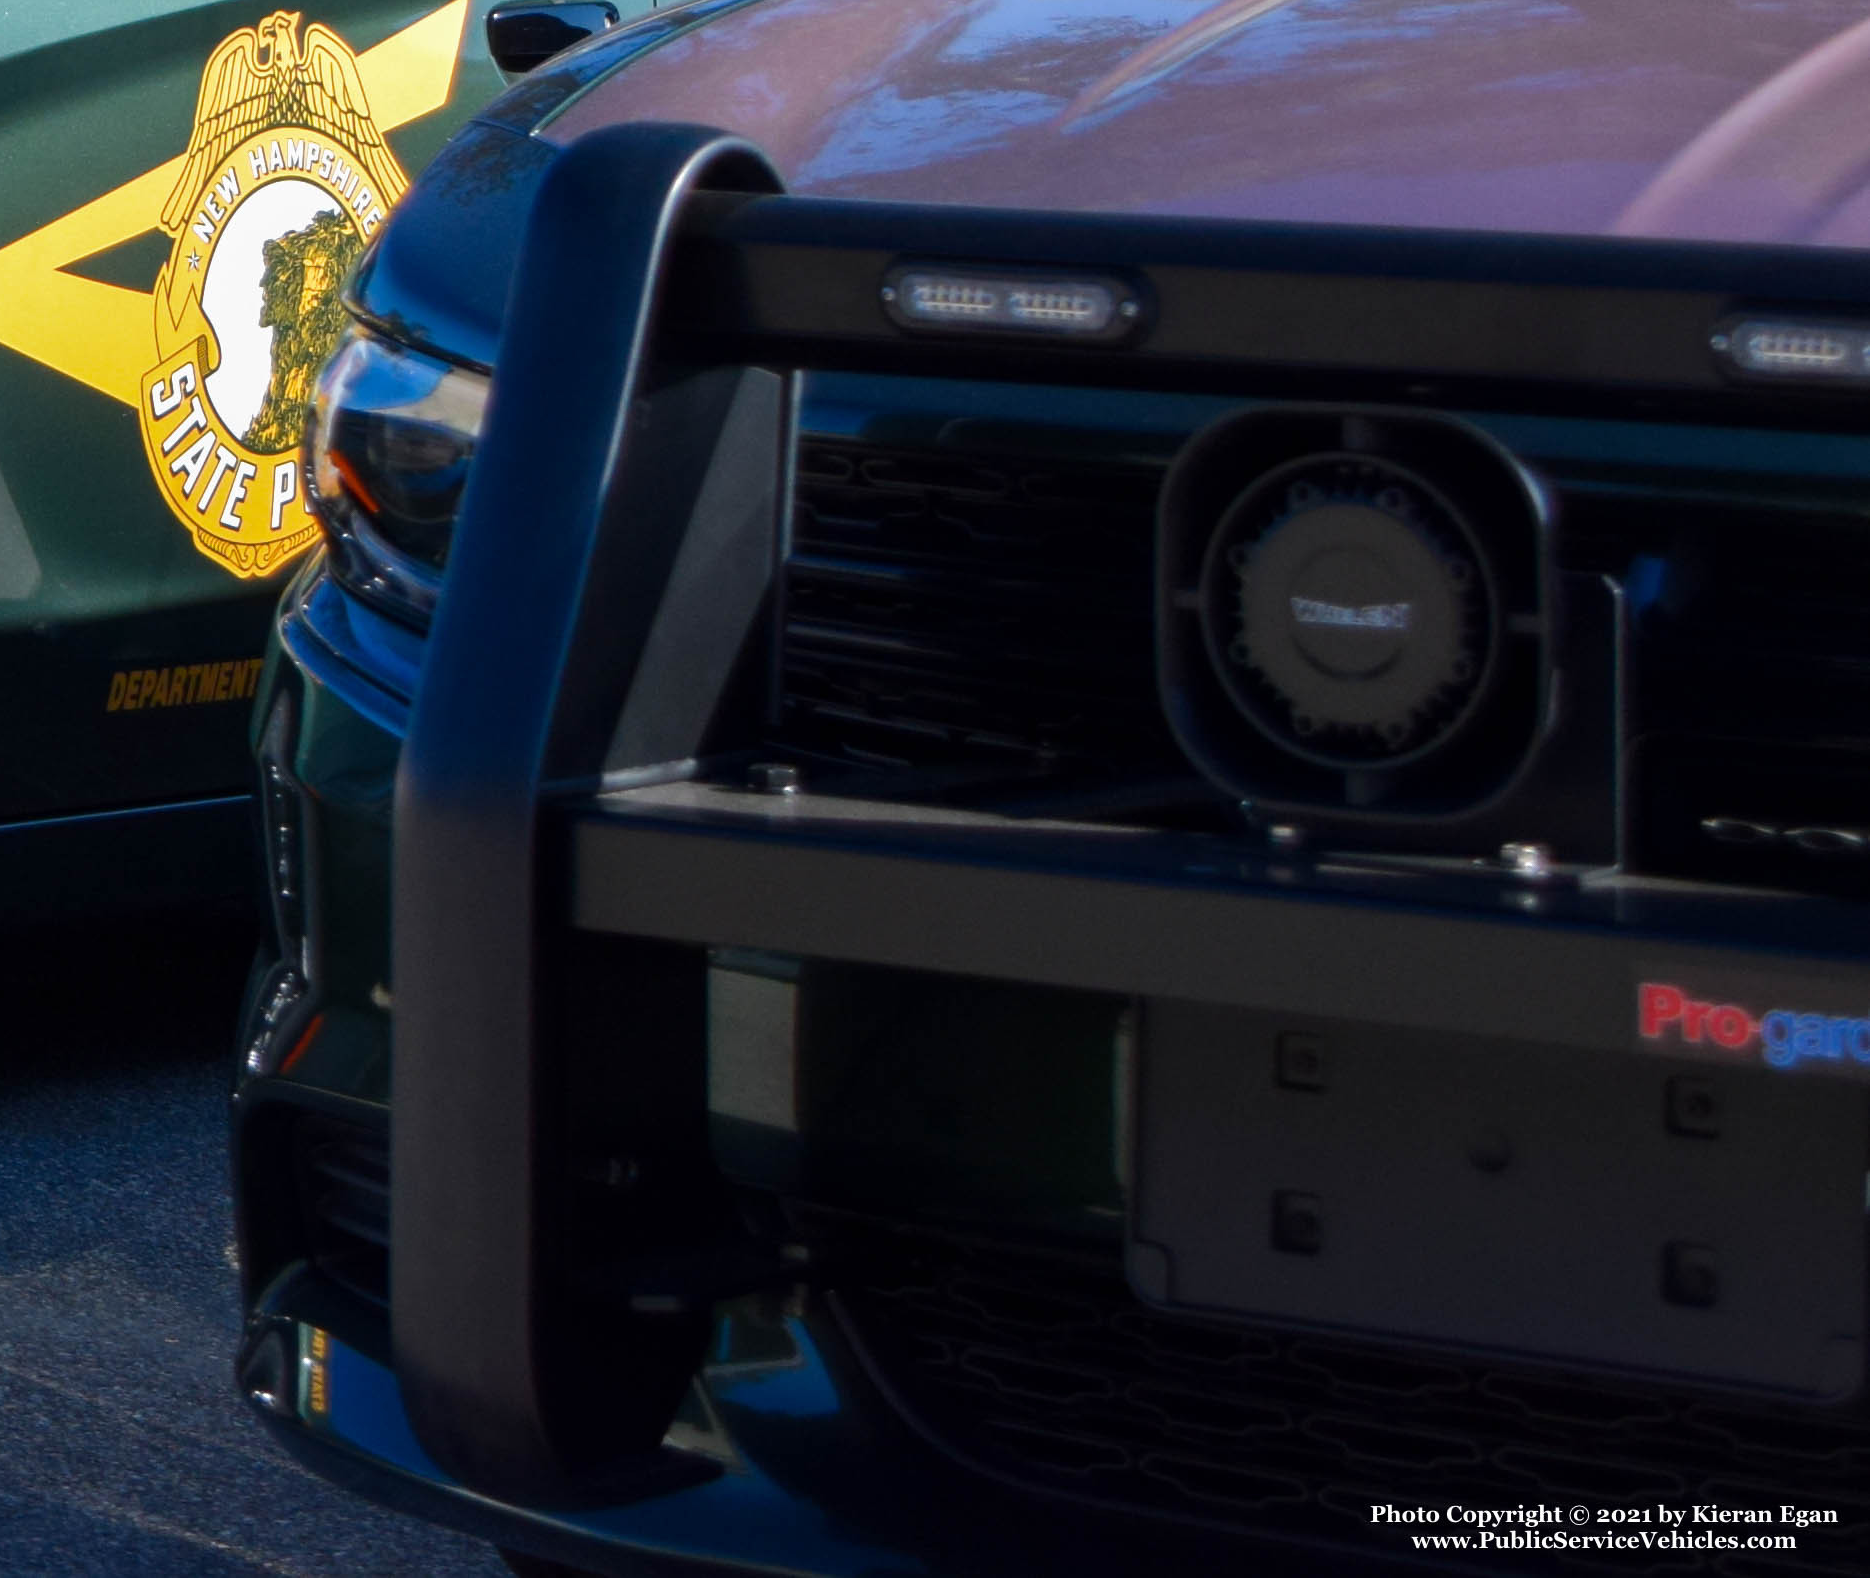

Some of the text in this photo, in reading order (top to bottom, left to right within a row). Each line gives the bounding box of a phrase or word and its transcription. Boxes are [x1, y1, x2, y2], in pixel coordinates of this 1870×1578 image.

[193, 138, 383, 244] NEW HAMPSHIRE
[150, 361, 256, 529] STATE
[107, 658, 264, 712] DEPARTMENT
